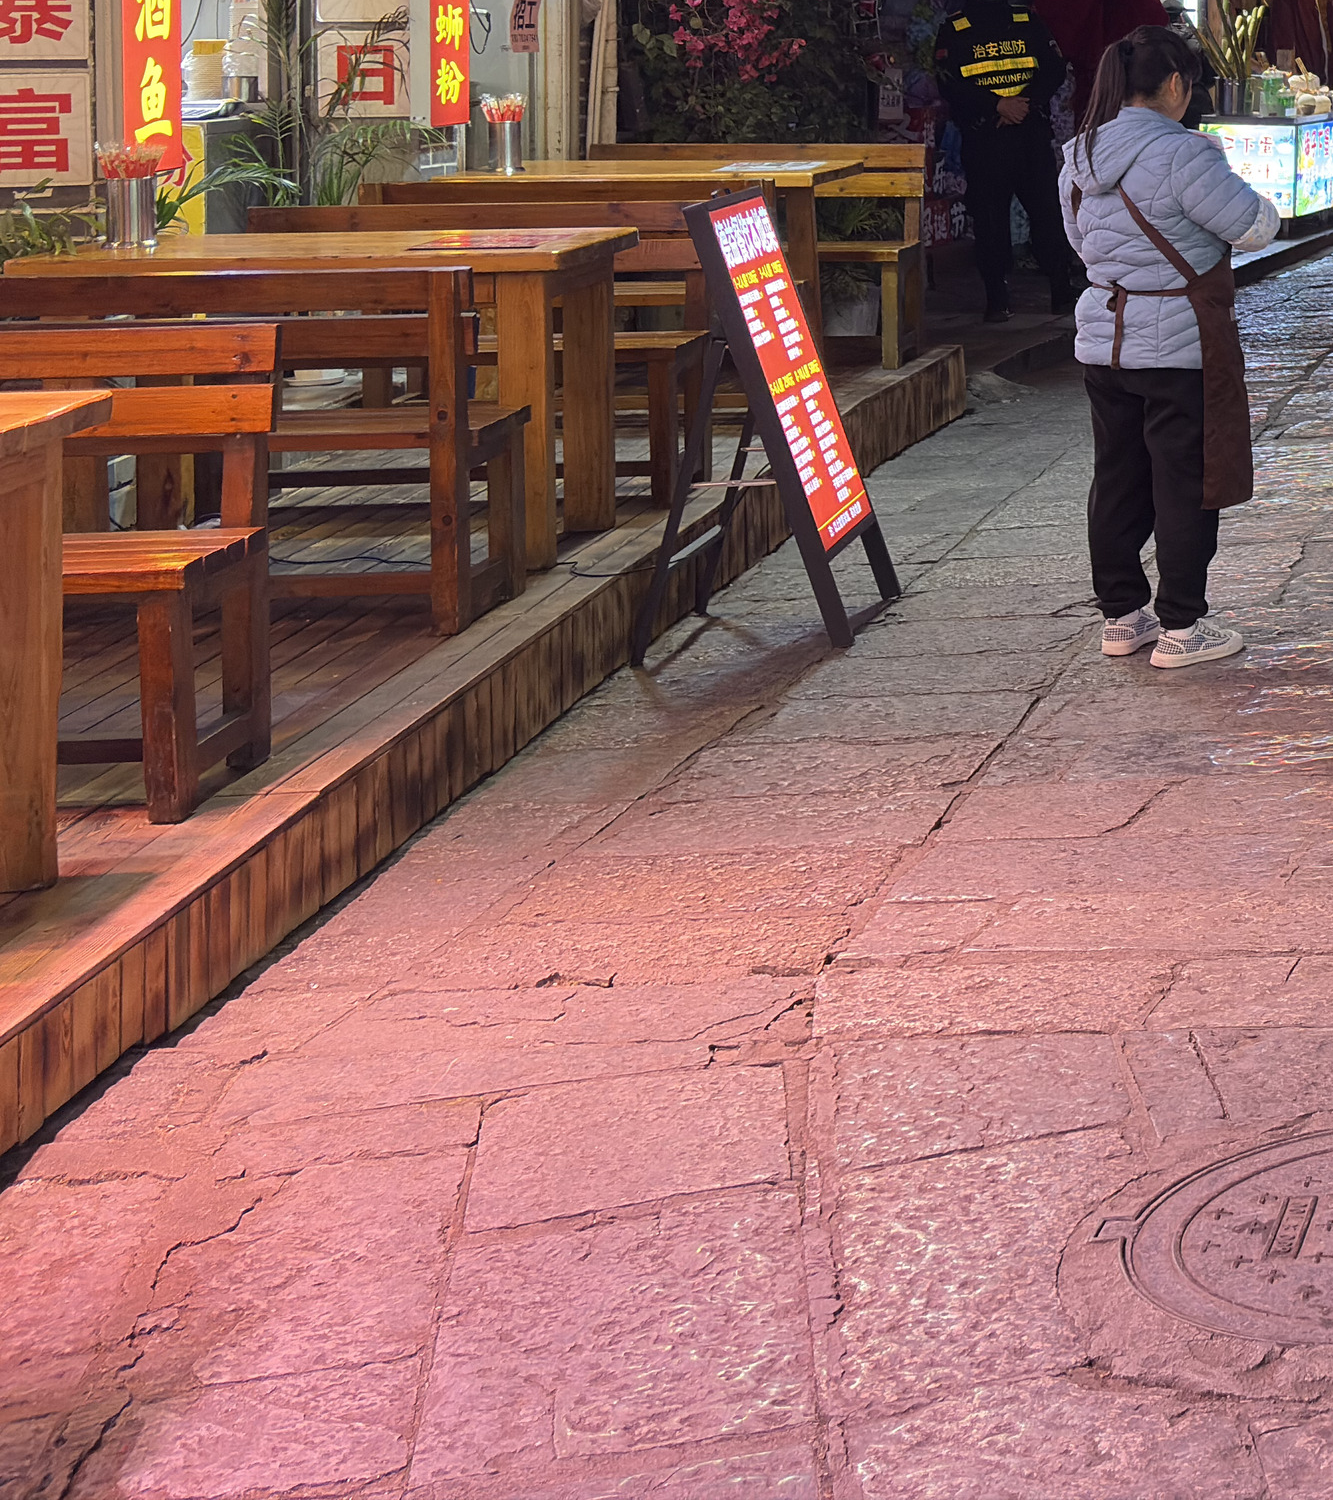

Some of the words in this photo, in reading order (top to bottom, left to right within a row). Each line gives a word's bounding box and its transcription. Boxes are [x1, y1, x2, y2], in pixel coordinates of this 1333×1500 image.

[514, 0, 537, 30] 招工
[972, 40, 1026, 58] 治安巡防
